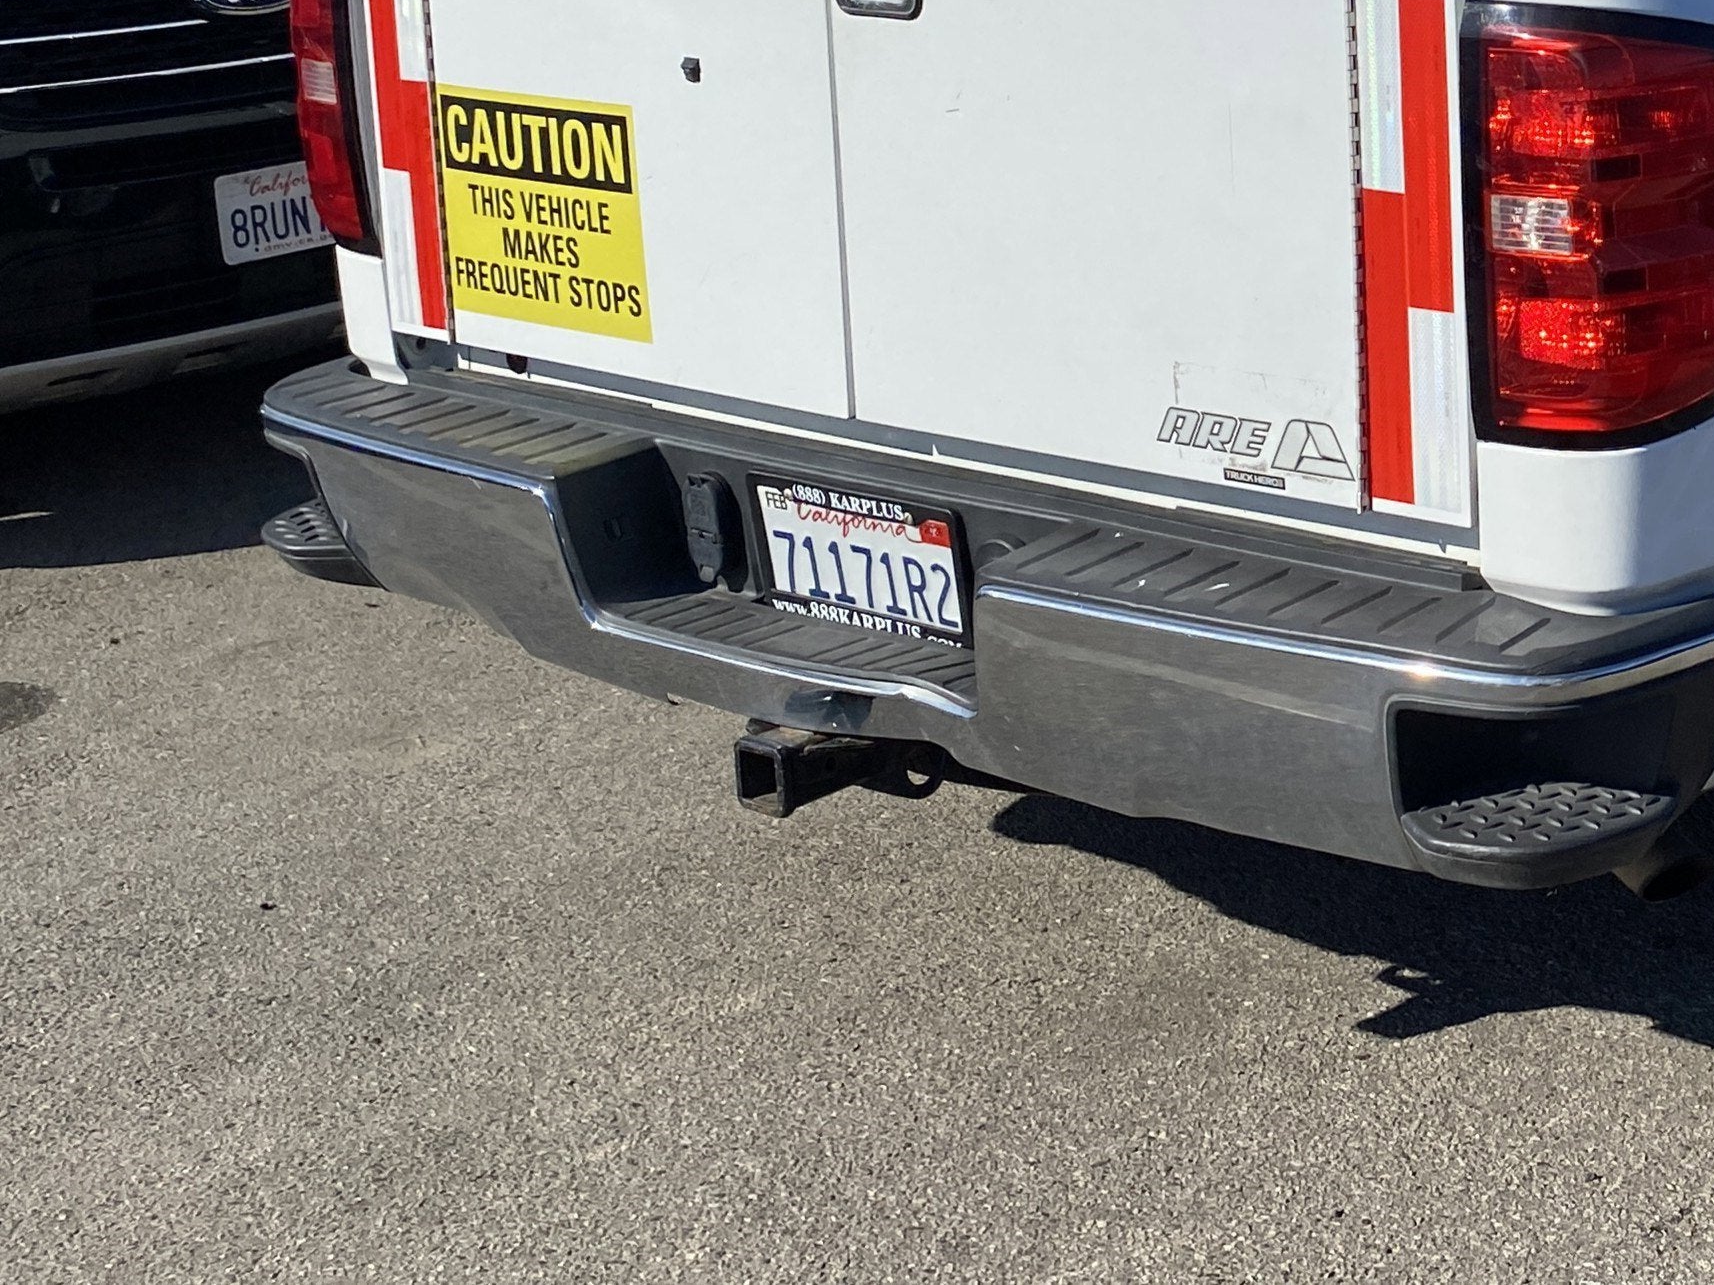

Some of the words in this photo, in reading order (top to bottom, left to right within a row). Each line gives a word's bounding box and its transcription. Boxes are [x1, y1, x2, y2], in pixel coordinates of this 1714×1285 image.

[446, 104, 626, 184] CAUTION
[231, 196, 326, 248] 8RUN
[468, 183, 514, 220] THIS
[520, 191, 612, 235] VEHICLE
[502, 227, 580, 269] MAKES
[455, 256, 561, 304] FREQUENT
[569, 275, 642, 317] STOPS
[1157, 406, 1272, 458] ARE
[765, 490, 788, 511] FEB
[792, 483, 826, 505] (888)
[828, 491, 904, 521] KARPLUS
[1225, 470, 1254, 483] TRUCK
[773, 529, 959, 627] 71171R2
